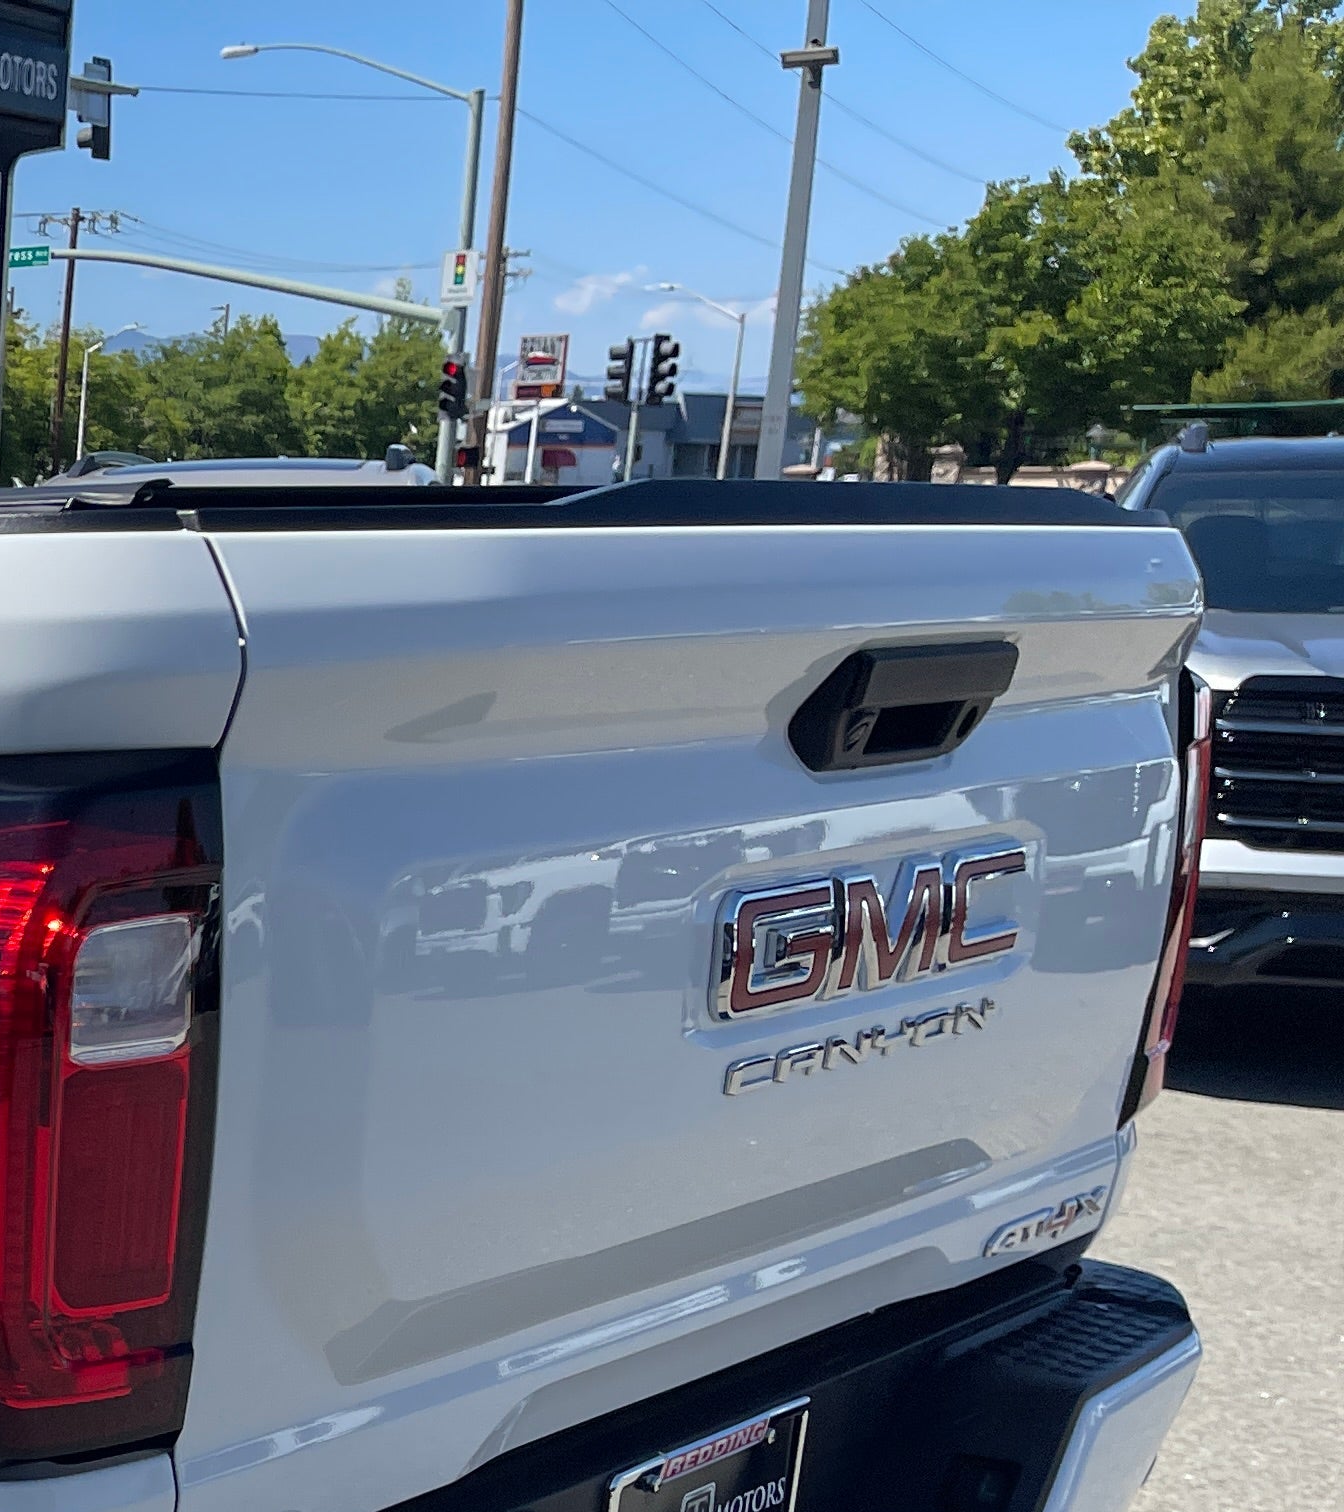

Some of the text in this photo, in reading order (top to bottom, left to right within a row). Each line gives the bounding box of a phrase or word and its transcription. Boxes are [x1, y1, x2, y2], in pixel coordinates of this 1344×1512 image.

[713, 846, 1027, 1021] GMC
[723, 997, 997, 1097] CANYON
[983, 1185, 1107, 1257] AT4X
[666, 1421, 765, 1477] REDDING
